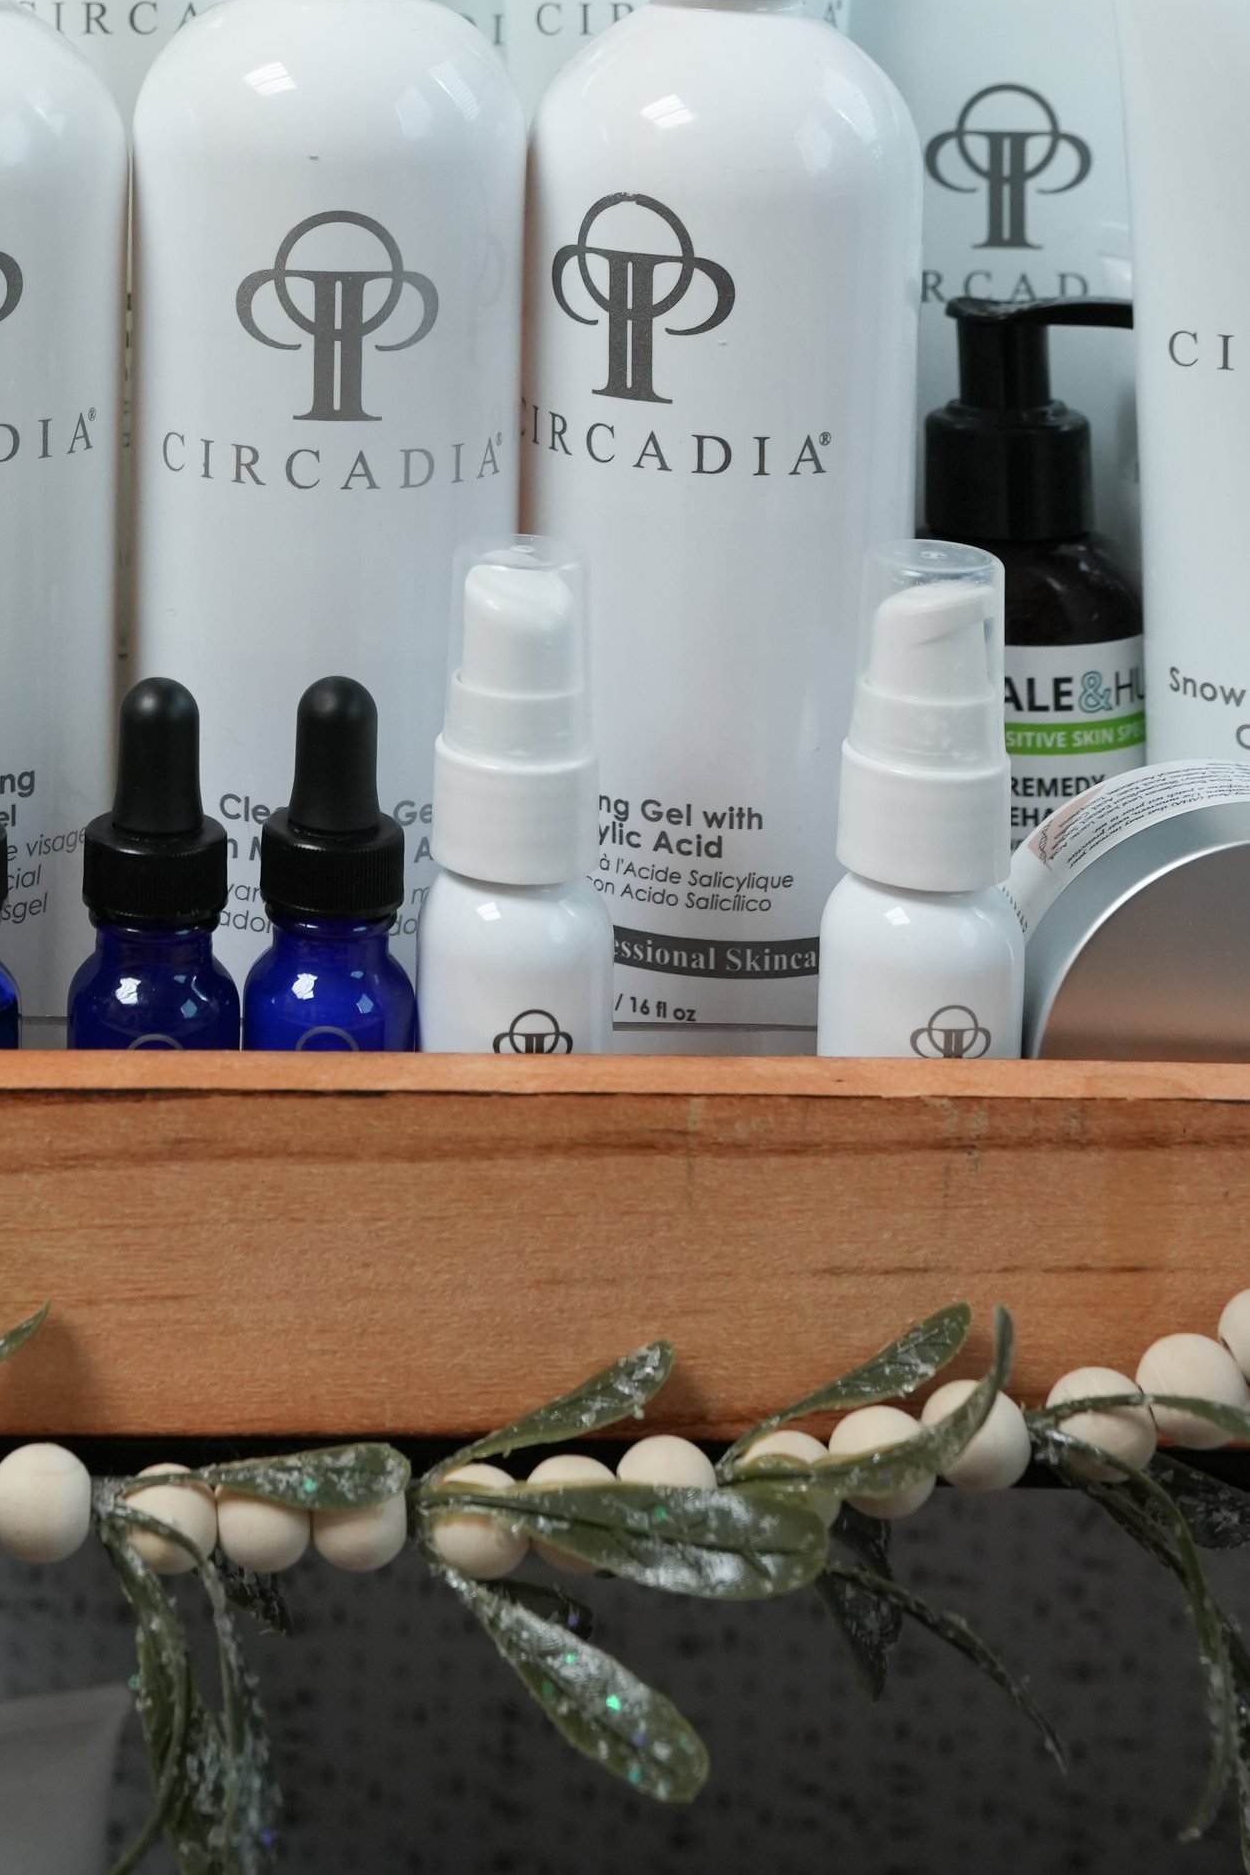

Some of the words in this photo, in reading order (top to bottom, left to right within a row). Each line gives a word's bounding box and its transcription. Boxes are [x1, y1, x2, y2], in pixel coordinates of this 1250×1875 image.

[520, 396, 832, 477] IRCADIA®
[1169, 666, 1247, 708] Snow
[1006, 731, 1067, 749] SITIVE
[1072, 727, 1114, 746] SKIN
[641, 799, 692, 827] Gel
[702, 807, 763, 830] with
[652, 830, 723, 859] Acid
[616, 858, 682, 885] l'Acide
[688, 869, 794, 893] Salicylique
[620, 883, 679, 907] Acido
[685, 891, 772, 913] Salicílico
[613, 938, 716, 971] essional
[725, 947, 817, 973] Skinca
[630, 996, 650, 1015] 16
[656, 1001, 667, 1019] fl
[673, 1008, 696, 1022] oz
